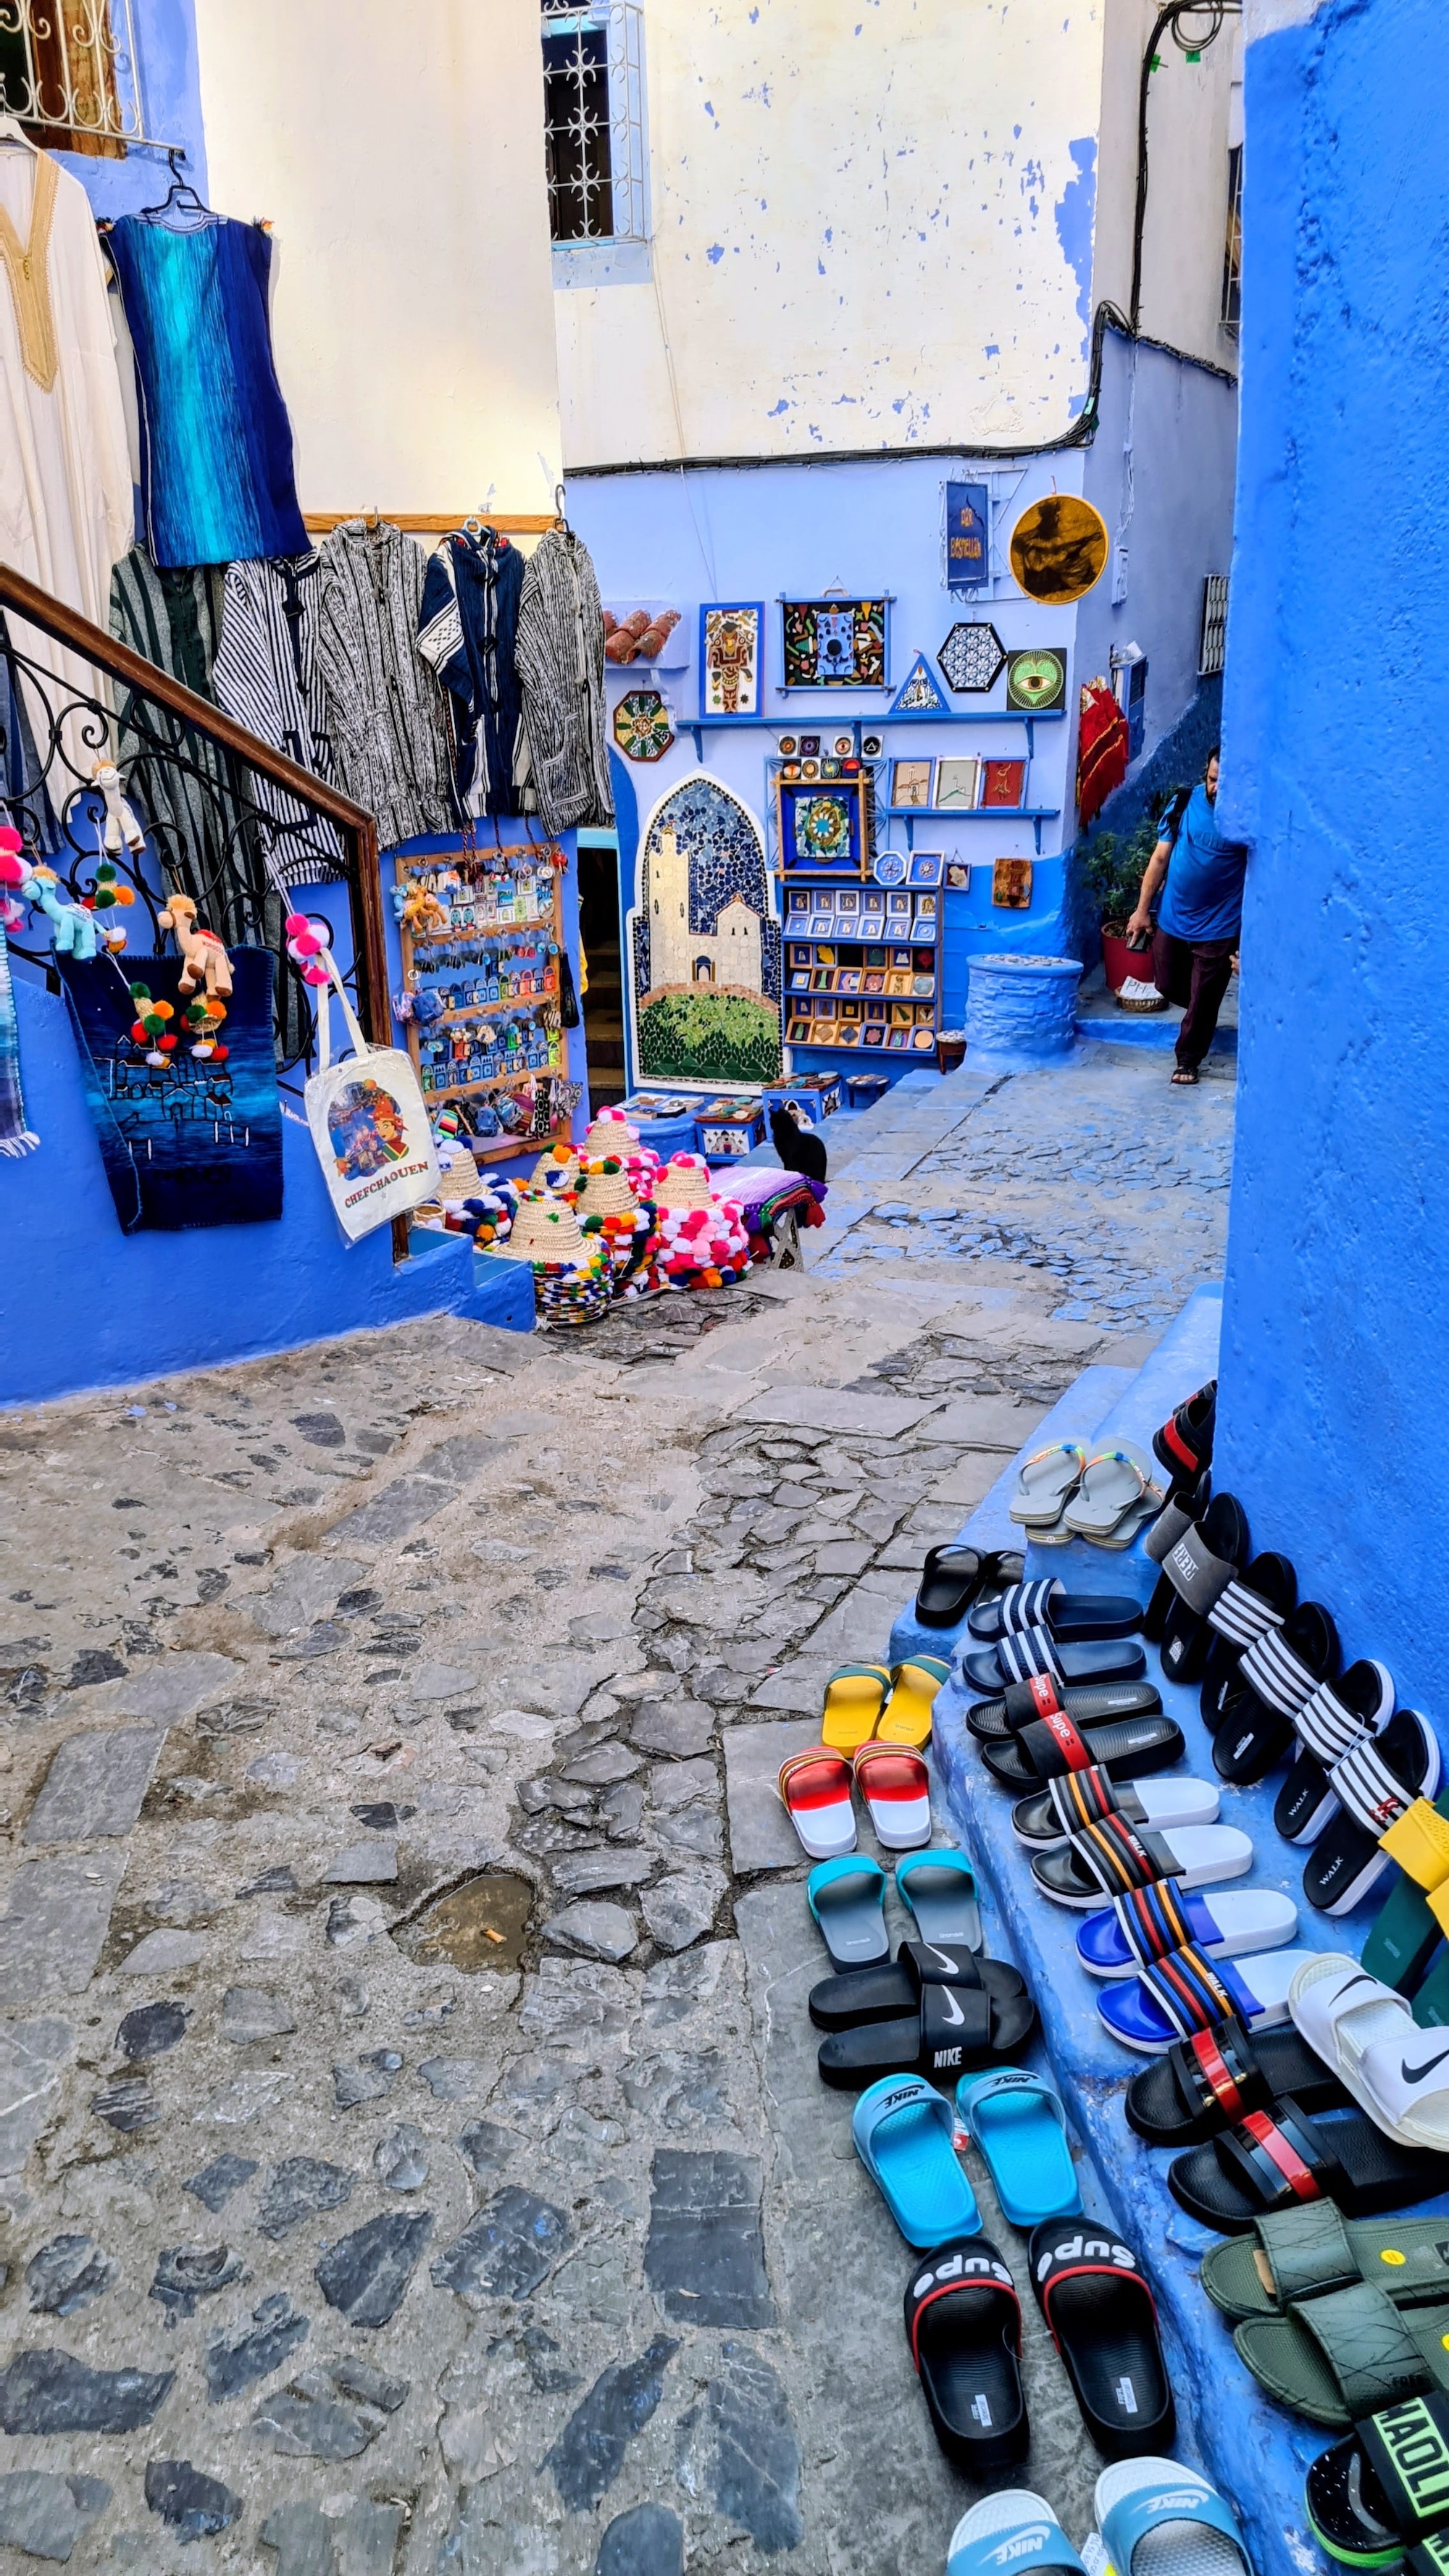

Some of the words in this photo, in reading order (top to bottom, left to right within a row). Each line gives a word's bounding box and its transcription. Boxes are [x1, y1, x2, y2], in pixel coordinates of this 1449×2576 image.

[344, 1161, 429, 1208] CHEFCHAOUEN
[1049, 1712, 1071, 1738] Supe
[1288, 1788, 1309, 1817] WALK
[1127, 1834, 1148, 1857] WALK
[1319, 1855, 1345, 1886] WALK
[1206, 1972, 1229, 1997] WALK
[933, 2046, 962, 2068] NIKE
[990, 2076, 1031, 2088] NIKE
[884, 2088, 919, 2109] NIKE
[1147, 2496, 1200, 2514] NIKE
[995, 2536, 1044, 2566] NIKE
